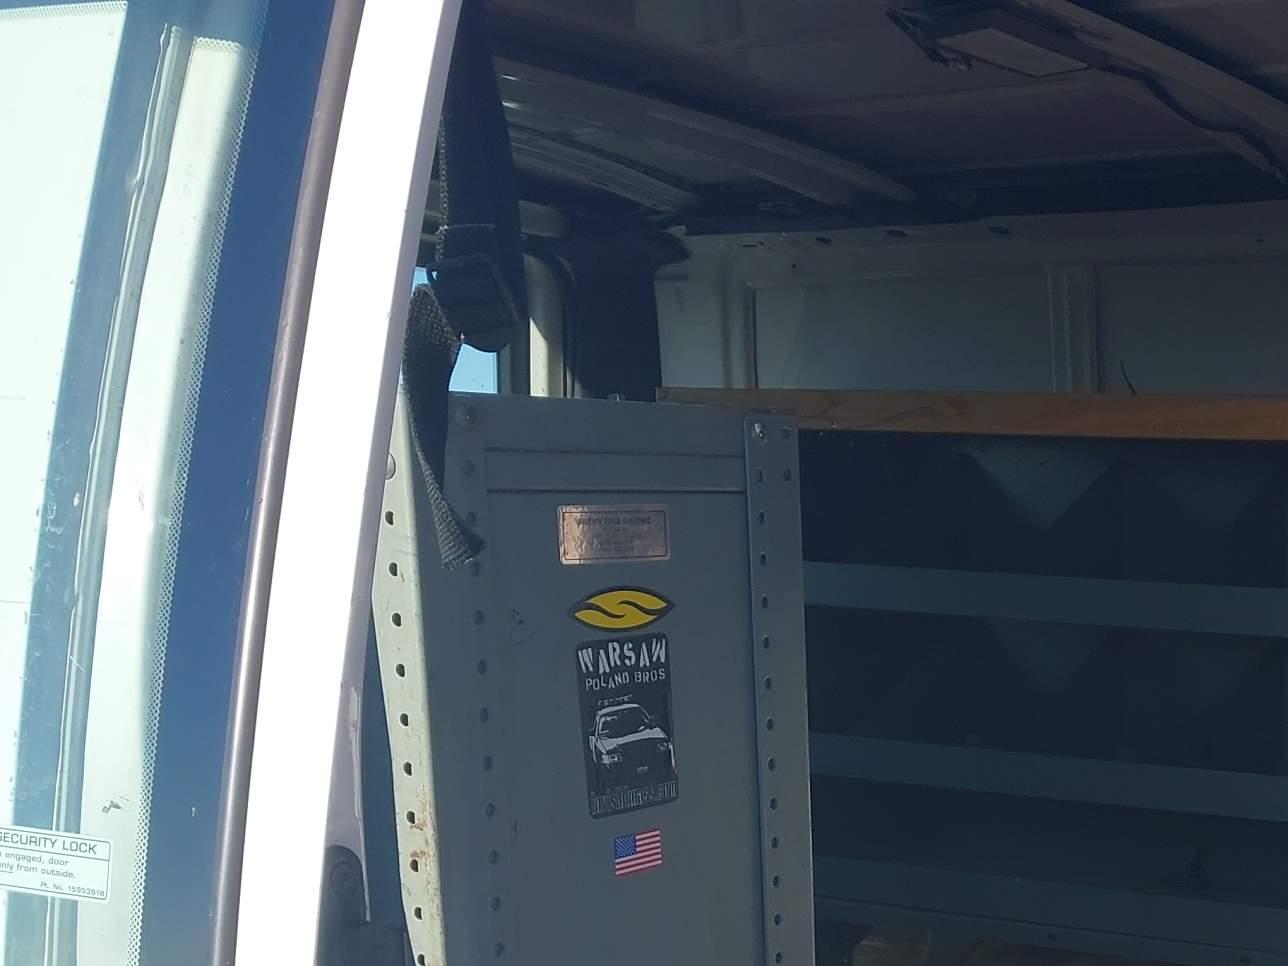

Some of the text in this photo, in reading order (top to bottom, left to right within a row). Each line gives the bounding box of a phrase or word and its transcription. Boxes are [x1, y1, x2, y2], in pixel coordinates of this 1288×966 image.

[577, 638, 666, 675] WARSAW
[585, 668, 666, 691] POLAND BROS
[62, 839, 98, 855] LOCK
[0, 861, 14, 872] nly
[16, 863, 38, 873] from
[5, 852, 45, 865] engaged,
[48, 857, 70, 866] door
